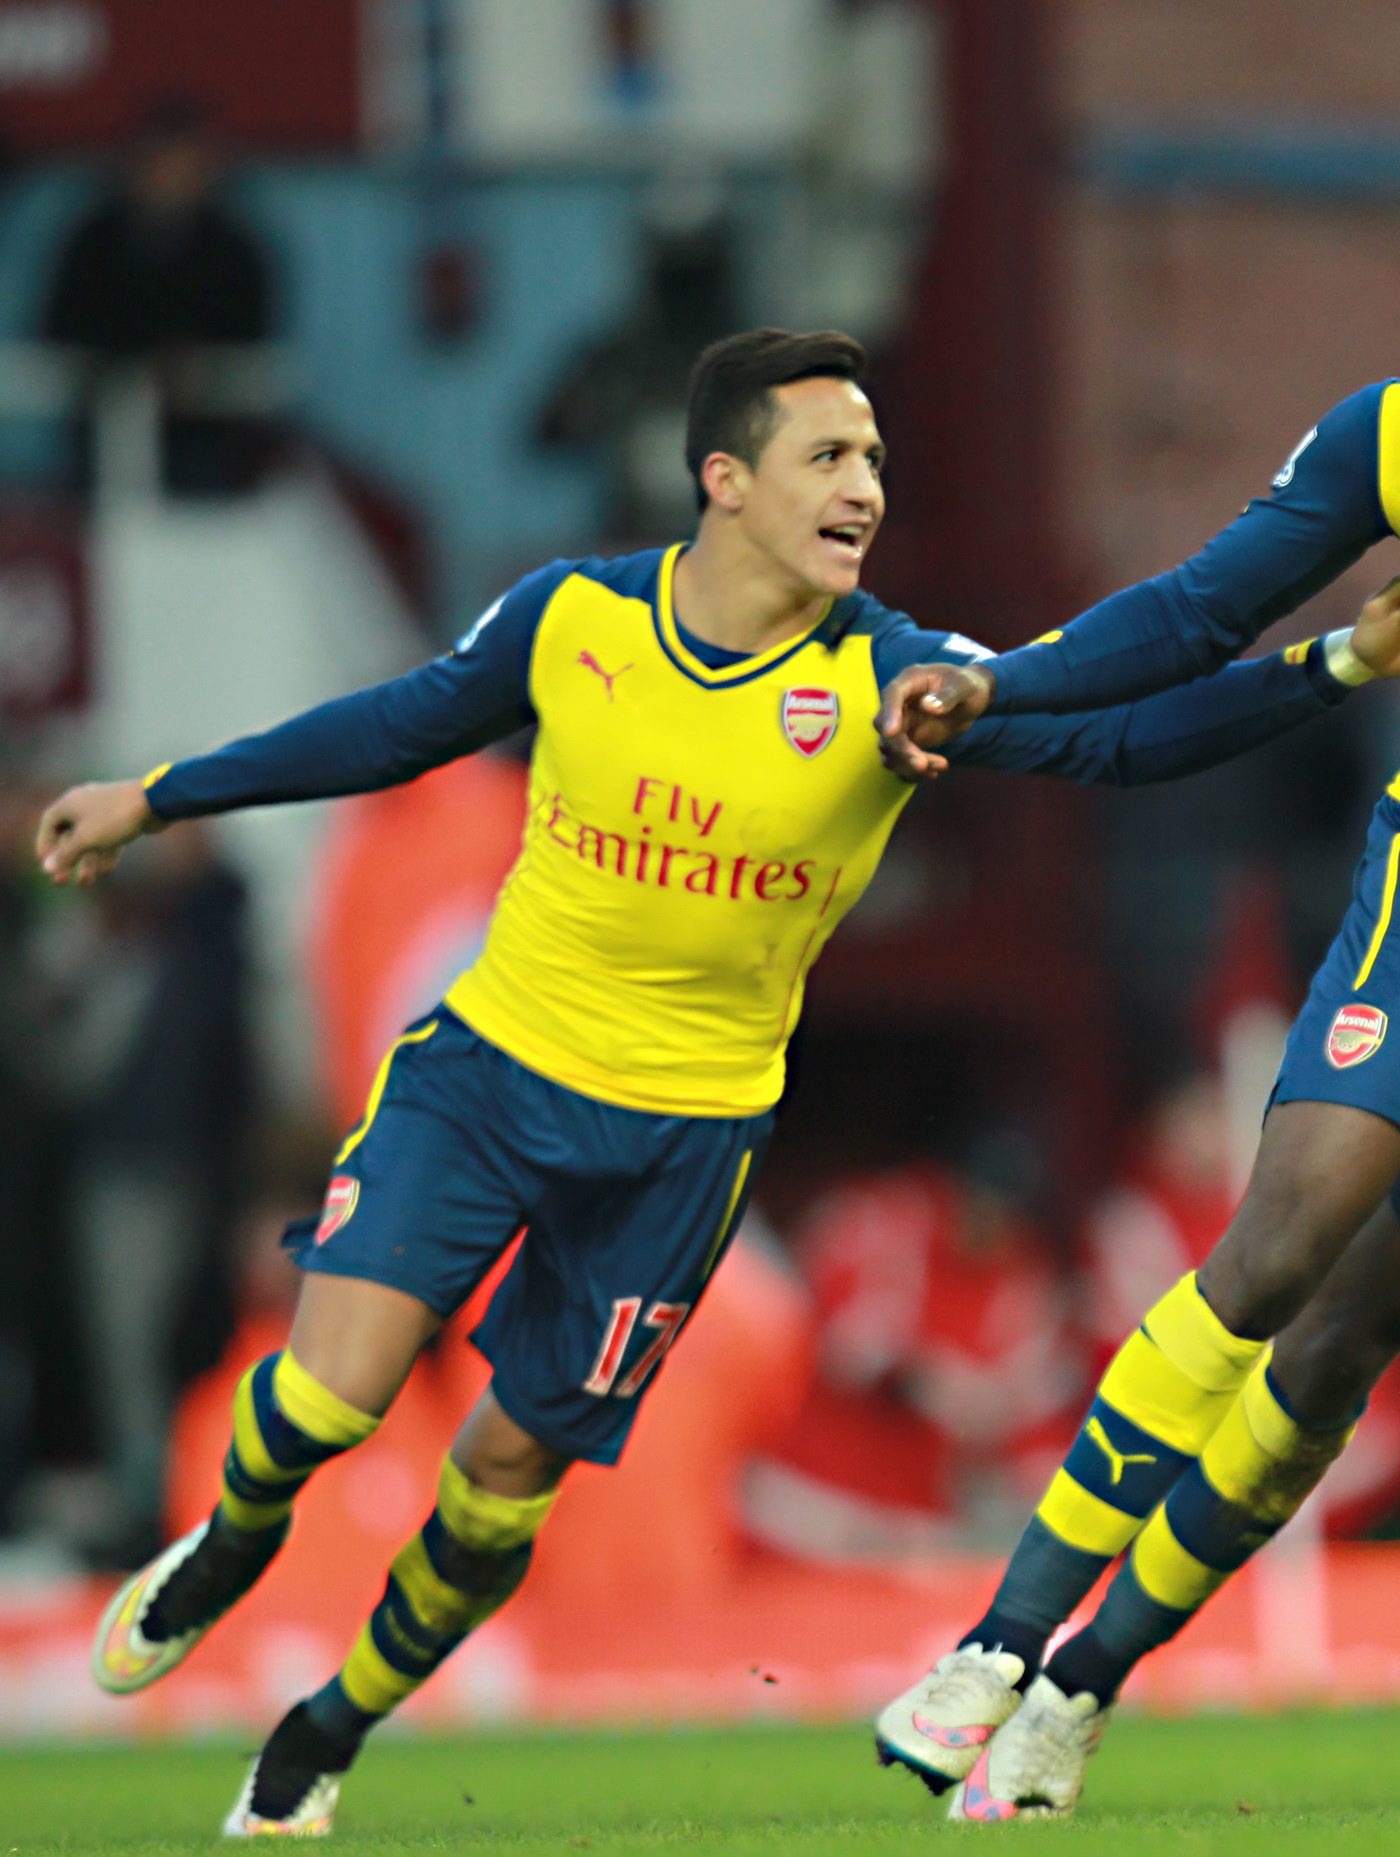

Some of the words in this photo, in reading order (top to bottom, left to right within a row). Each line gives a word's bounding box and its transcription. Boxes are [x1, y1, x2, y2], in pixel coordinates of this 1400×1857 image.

[547, 793, 817, 901] Emirates
[632, 776, 723, 838] Fly
[1336, 1013, 1380, 1031] Arsenal
[582, 1296, 691, 1398] 17
